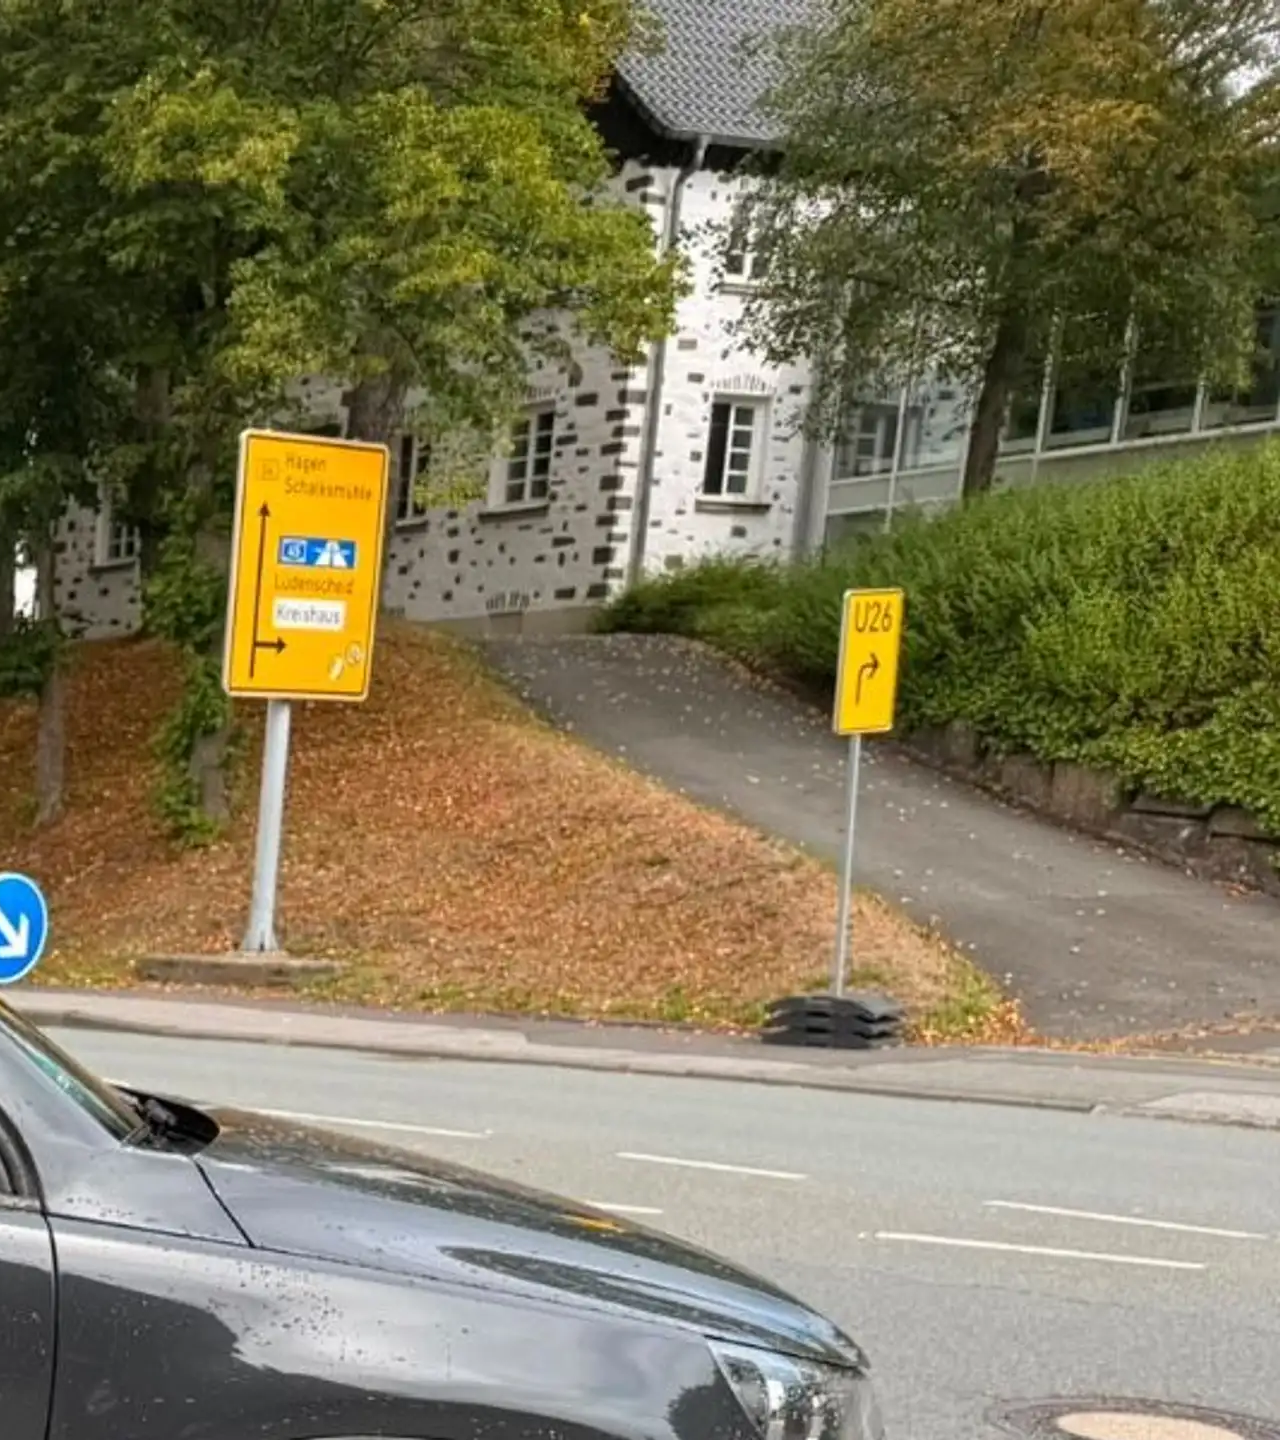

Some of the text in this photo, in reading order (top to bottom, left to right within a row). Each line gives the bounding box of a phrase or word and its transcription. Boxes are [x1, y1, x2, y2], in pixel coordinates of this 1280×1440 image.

[284, 451, 327, 474] Hagen
[276, 602, 341, 625] Kreishaus
[854, 601, 893, 632] U26
